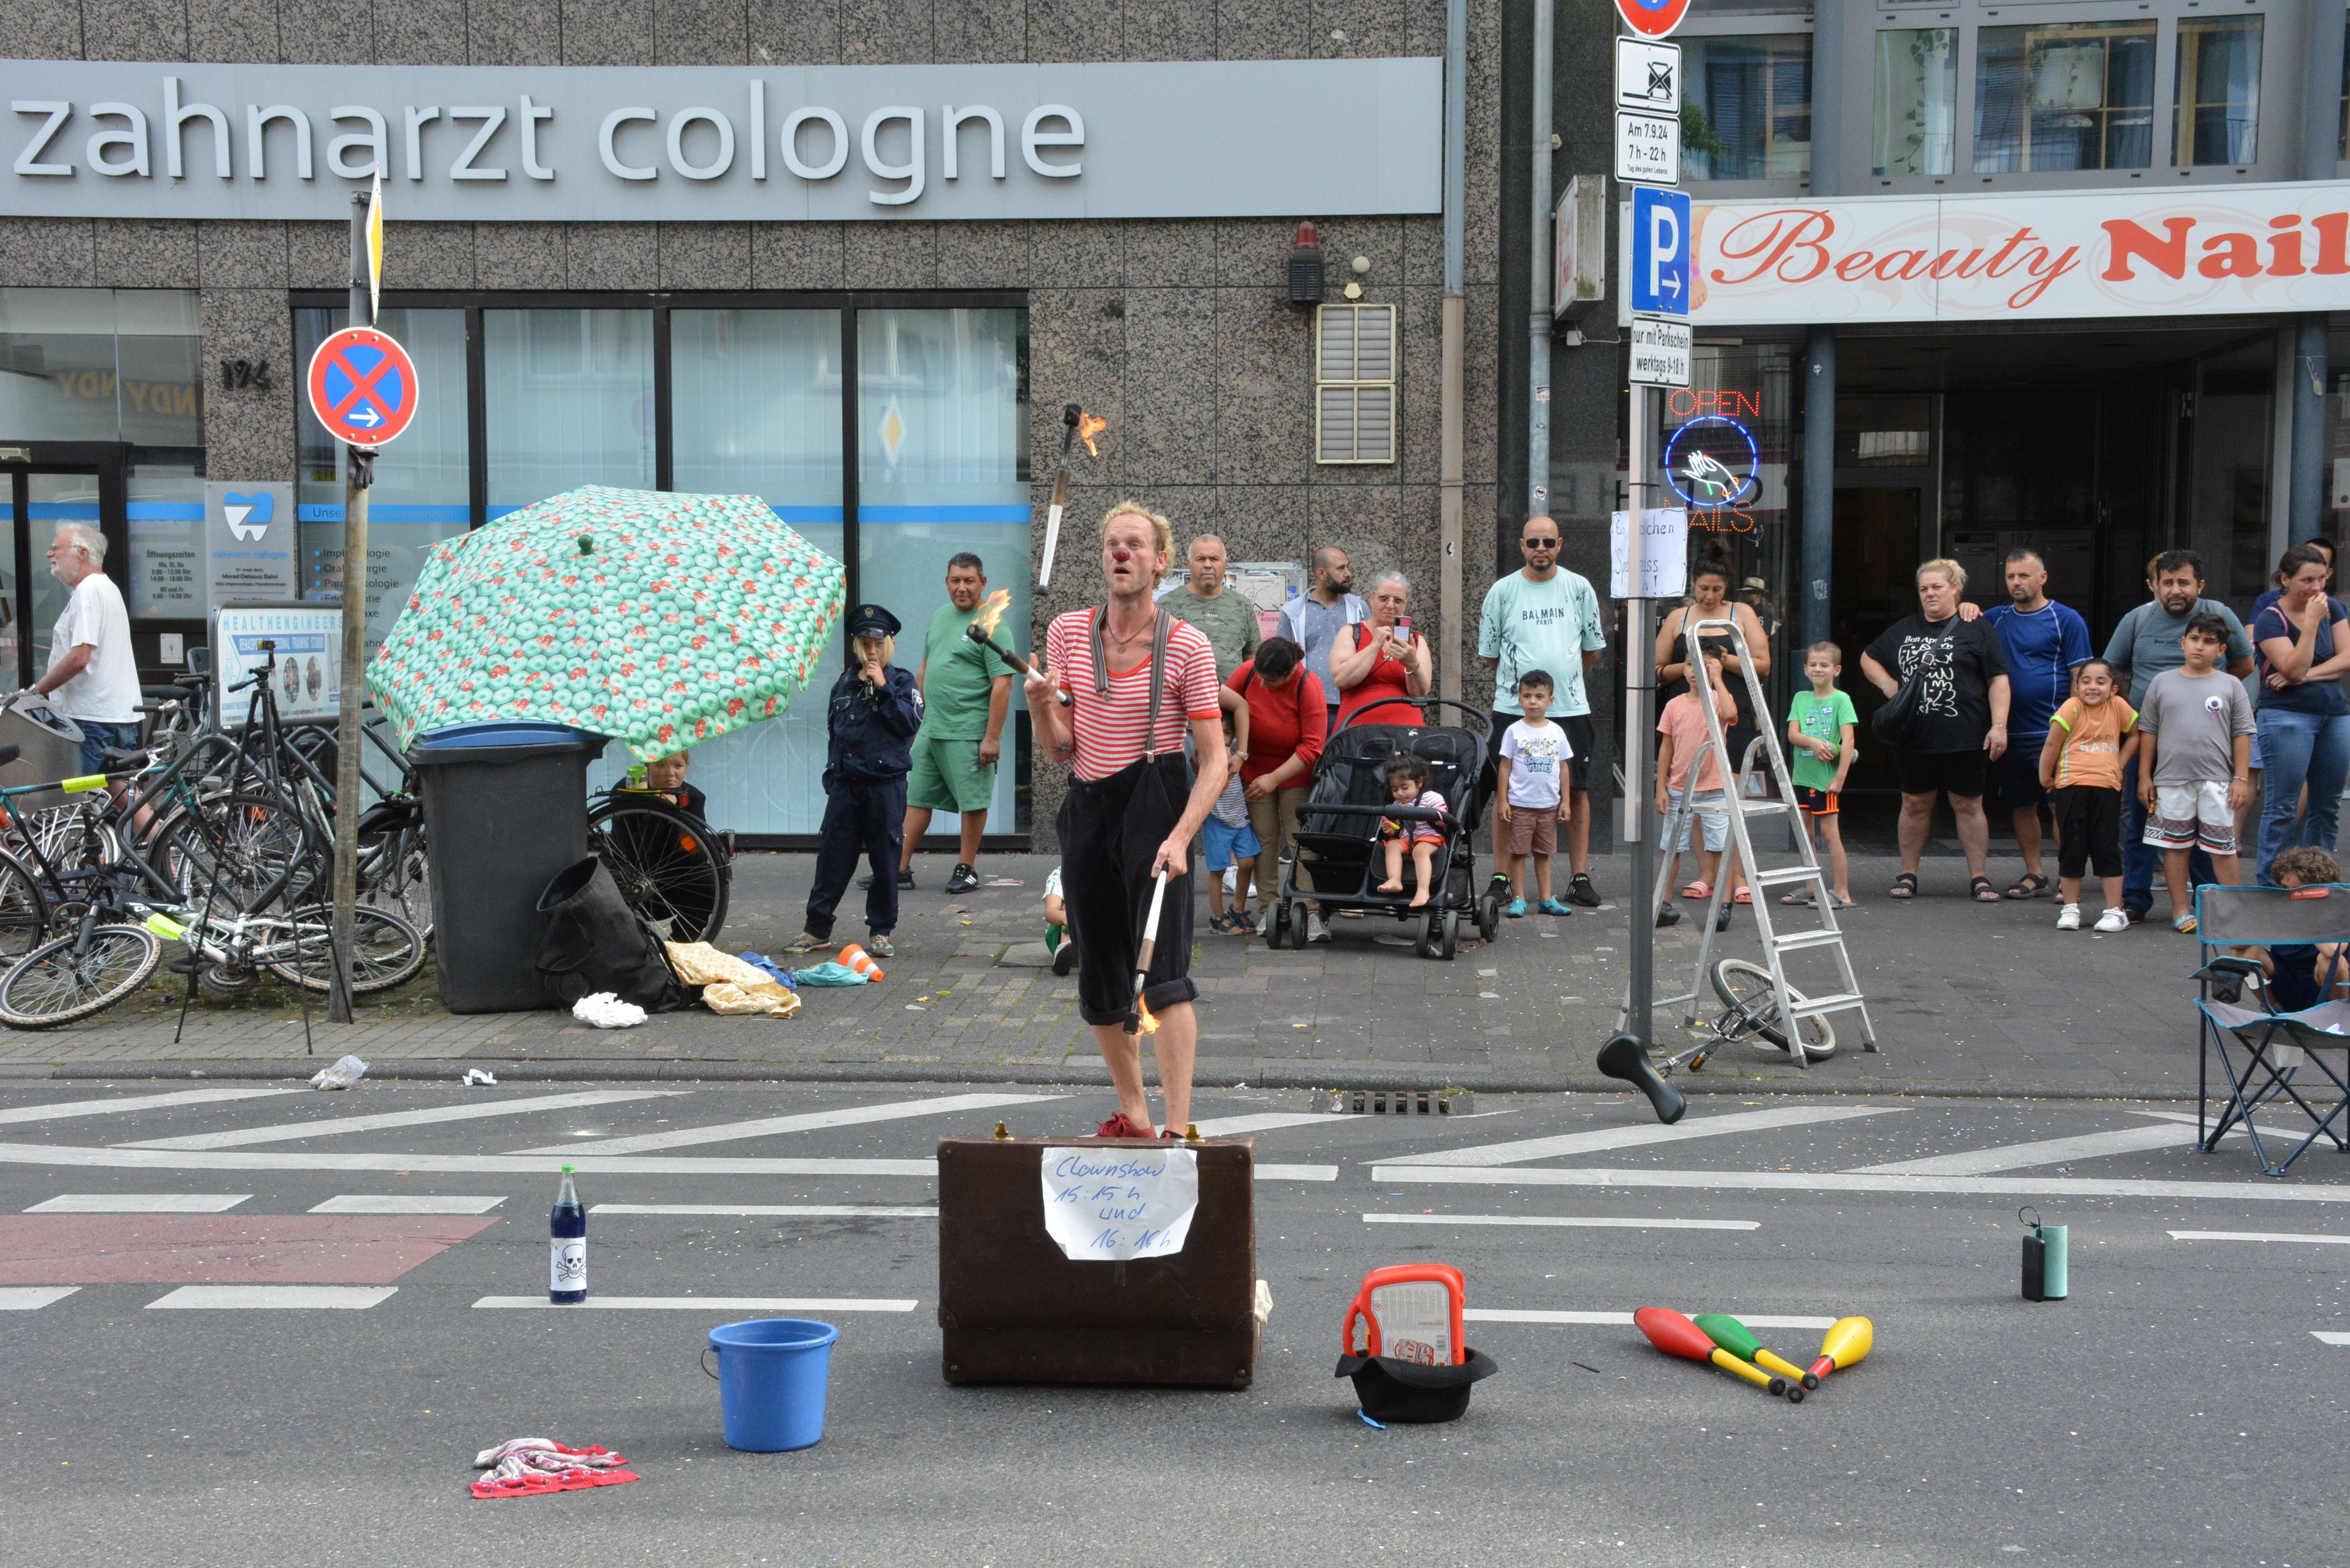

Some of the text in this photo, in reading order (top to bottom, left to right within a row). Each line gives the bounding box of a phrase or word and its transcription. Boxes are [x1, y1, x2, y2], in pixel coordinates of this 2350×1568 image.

[1628, 122, 1668, 140] Am 7.9.24
[11, 76, 1085, 205] zahnarzt cologne
[1629, 145, 1634, 159] 7
[1636, 145, 1641, 160] h
[1650, 147, 1659, 162] 22
[1660, 147, 1666, 162] h
[1642, 166, 1653, 174] guten
[1650, 205, 1678, 296] P
[1711, 209, 2350, 309] Beauty Nail
[1646, 328, 1656, 345] mit
[1658, 329, 1688, 350] Parkschein
[1637, 354, 1684, 376] werktags 9-18 h
[1669, 389, 1760, 417] OPEN
[1664, 497, 1754, 532] AILS
[146, 549, 196, 559] Öffnungszeiten
[1522, 607, 1565, 621] BALMAIN
[1536, 617, 1553, 626] PARIS
[223, 616, 343, 631] HEALTHENGINEERS
[2080, 742, 2119, 754] HAPP
[1524, 756, 1555, 765] LOONEY
[1528, 764, 1553, 773] TUNES
[1056, 1156, 1166, 1178] Clownshow
[1099, 1203, 1146, 1220] und
